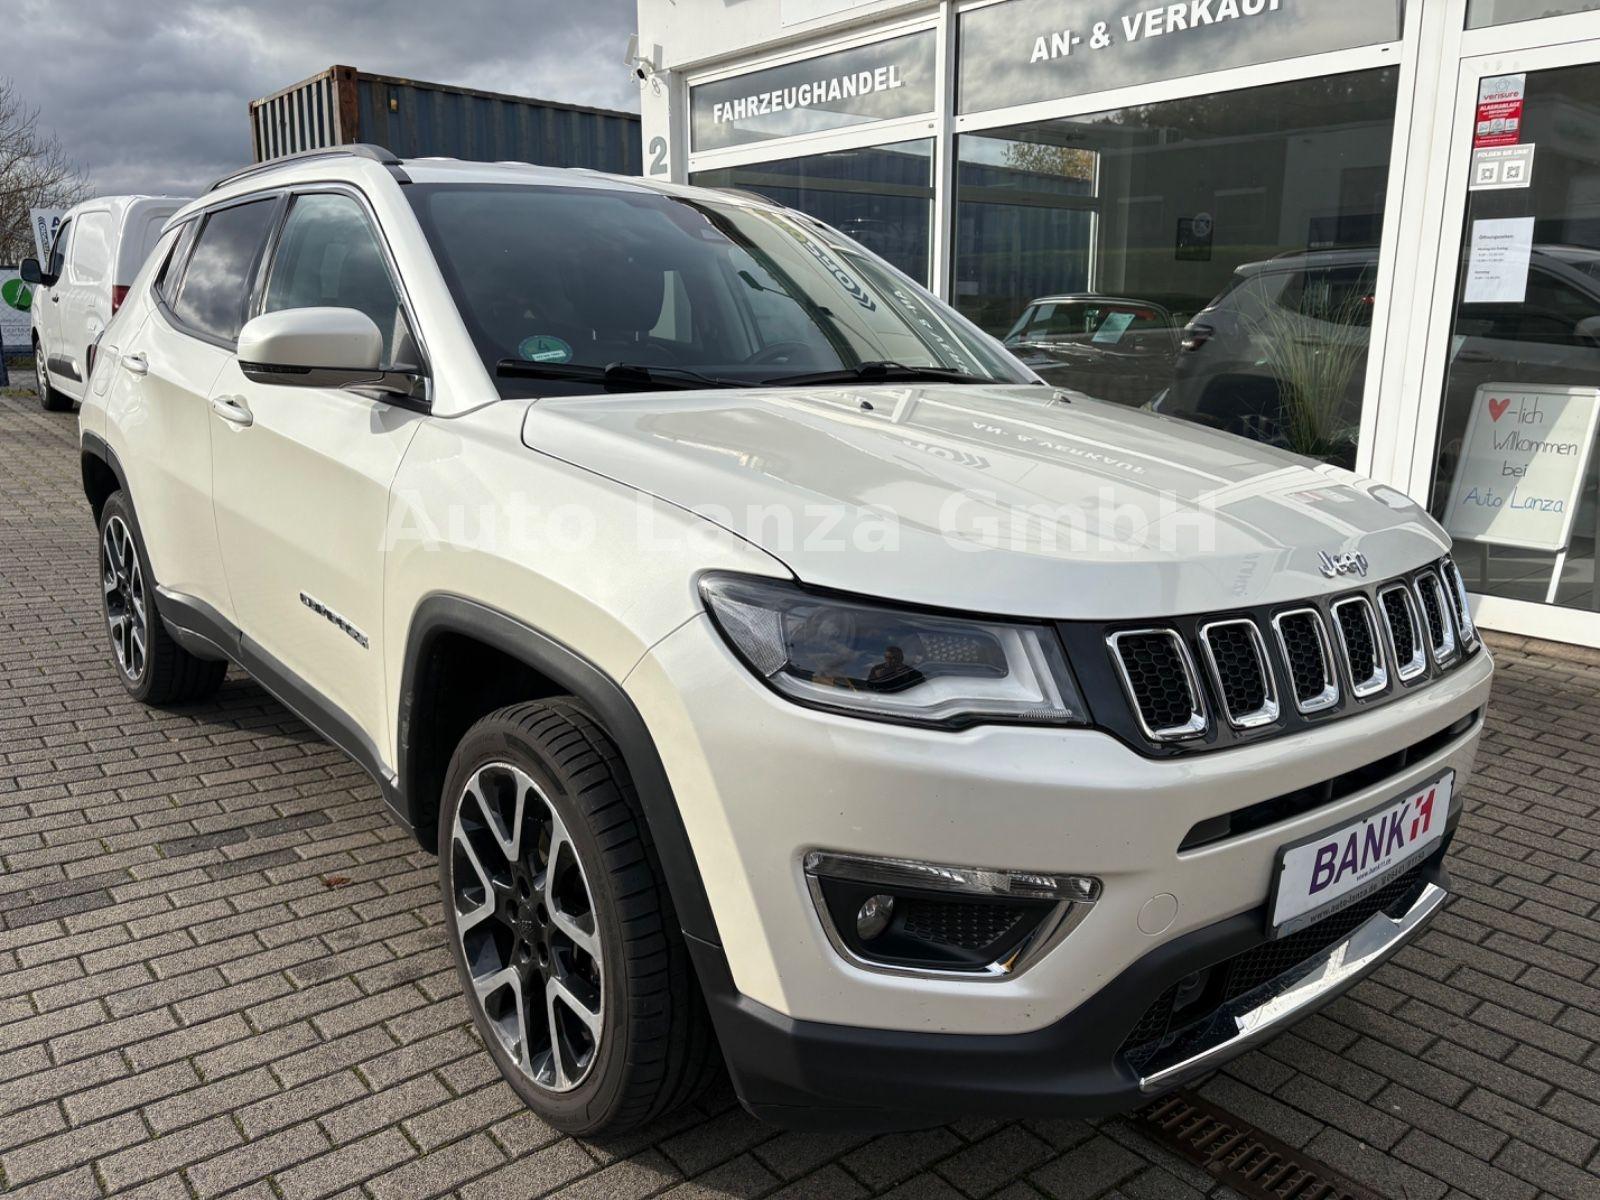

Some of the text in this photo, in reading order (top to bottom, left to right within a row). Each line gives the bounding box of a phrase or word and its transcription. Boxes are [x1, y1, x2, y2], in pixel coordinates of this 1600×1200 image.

[1030, 29, 1080, 63] AN-
[1089, 21, 1110, 50] &
[713, 65, 901, 124] FAHRZEUGHANDEL
[1483, 91, 1520, 101] verisure
[649, 136, 668, 175] 2
[1502, 460, 1528, 478] bei
[1463, 485, 1564, 513] Auto Lanza
[1318, 551, 1369, 579] Jeep
